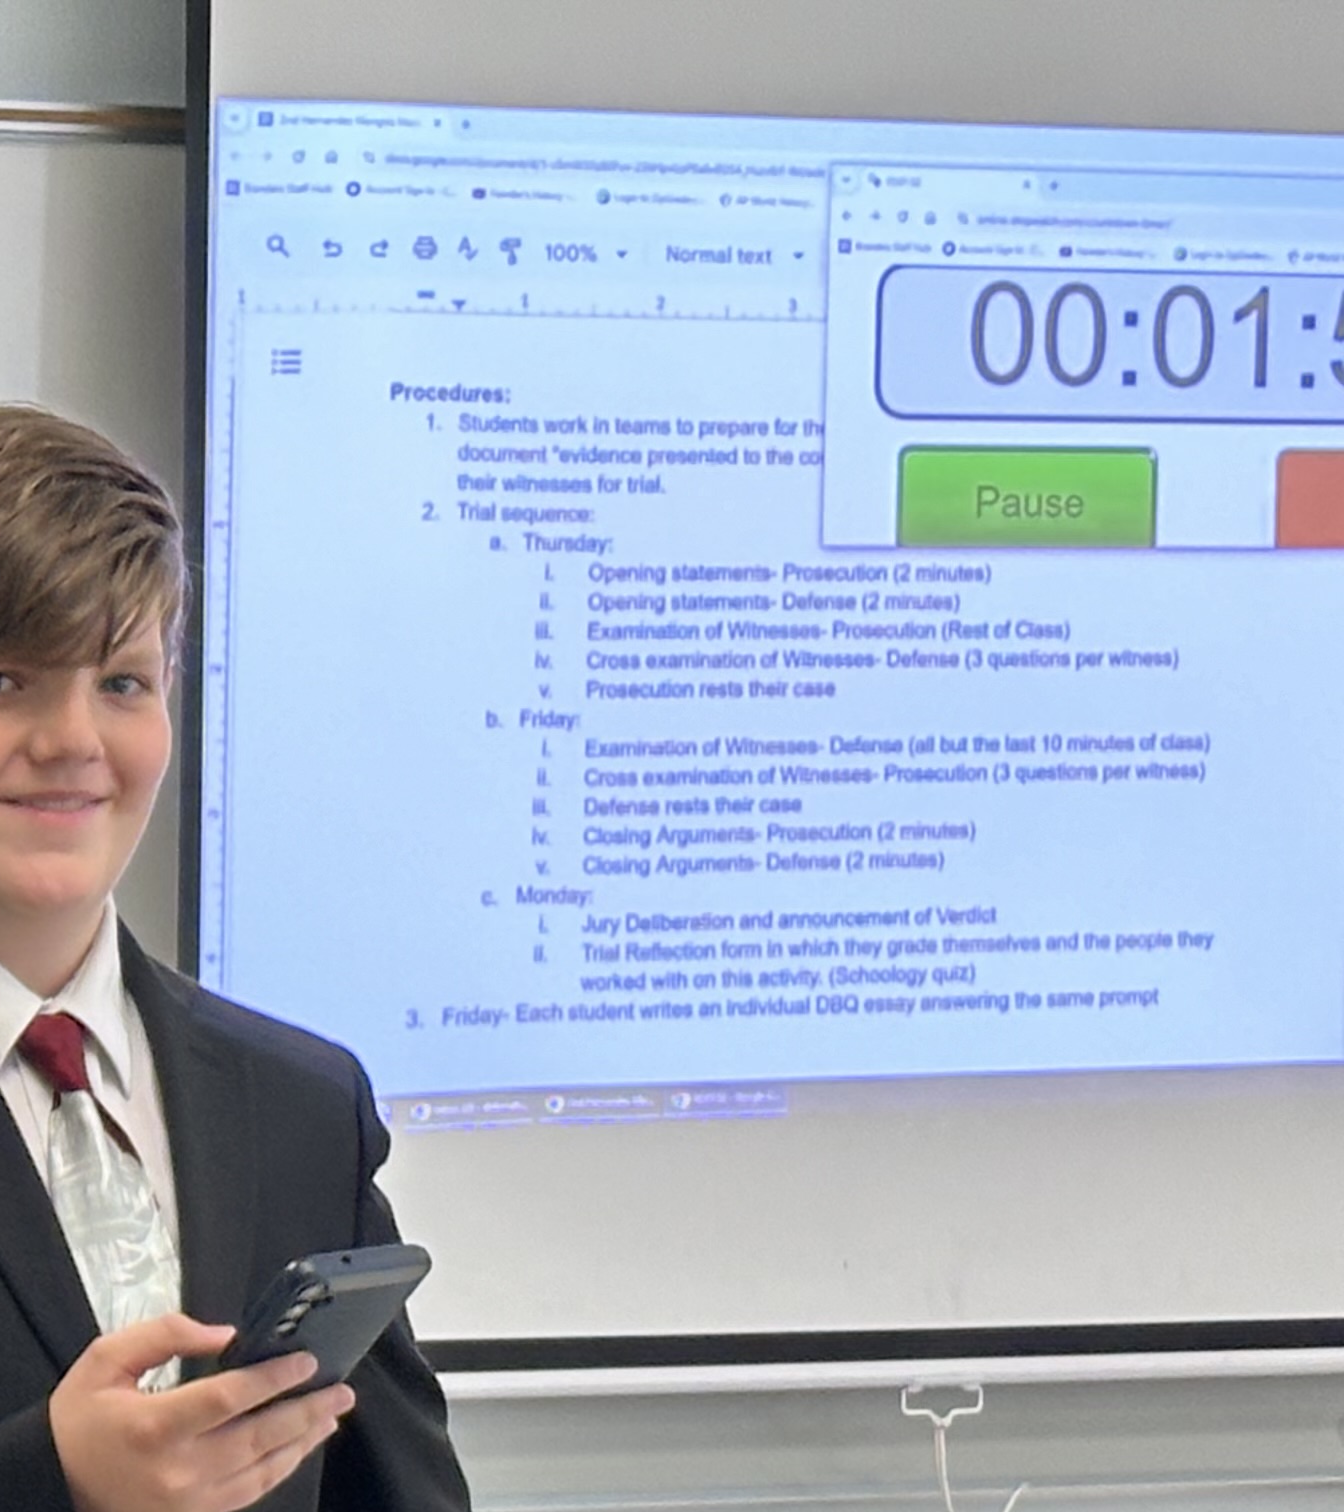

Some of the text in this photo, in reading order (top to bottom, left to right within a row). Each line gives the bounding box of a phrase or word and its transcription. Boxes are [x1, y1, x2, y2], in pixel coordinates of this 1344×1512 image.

[545, 243, 773, 266] 100% Normal text
[969, 279, 1344, 389] 00:01:
[391, 382, 510, 402] Procedures:
[459, 414, 538, 432] Students
[545, 416, 587, 433] work
[593, 417, 609, 433] in
[615, 418, 671, 435] teams
[677, 418, 694, 435] to
[699, 422, 768, 439] prepare
[775, 418, 797, 436] for
[458, 444, 546, 462] document
[648, 448, 737, 468] presented
[744, 449, 760, 464] to
[767, 449, 793, 465] the
[457, 474, 664, 494] their witnesses for trial.
[458, 501, 496, 521] Trial
[502, 508, 594, 525] sequence:
[975, 484, 1086, 520] Pause
[524, 533, 612, 555] Thursday:
[589, 563, 666, 584] Opening
[673, 565, 776, 581] statements-
[783, 563, 887, 581] Prosecution
[917, 565, 991, 585] minutes)
[588, 593, 665, 614] Opening
[672, 595, 776, 610] statements-
[783, 593, 856, 610] Defense
[885, 594, 960, 613] minutes)
[587, 680, 694, 699] Prosecution
[700, 682, 742, 698] rests
[749, 681, 788, 697] their
[794, 683, 835, 697] case
[520, 709, 580, 732] Friday:
[584, 797, 659, 816] Defense
[666, 799, 709, 814] rests
[715, 798, 754, 813] their
[759, 799, 802, 812] case
[517, 885, 592, 908] Monday:
[582, 915, 620, 936] Jury
[626, 912, 734, 931] Deliberation
[740, 911, 773, 929] and
[779, 911, 909, 927] announcement
[915, 907, 932, 925] of
[937, 907, 996, 924] Verdict
